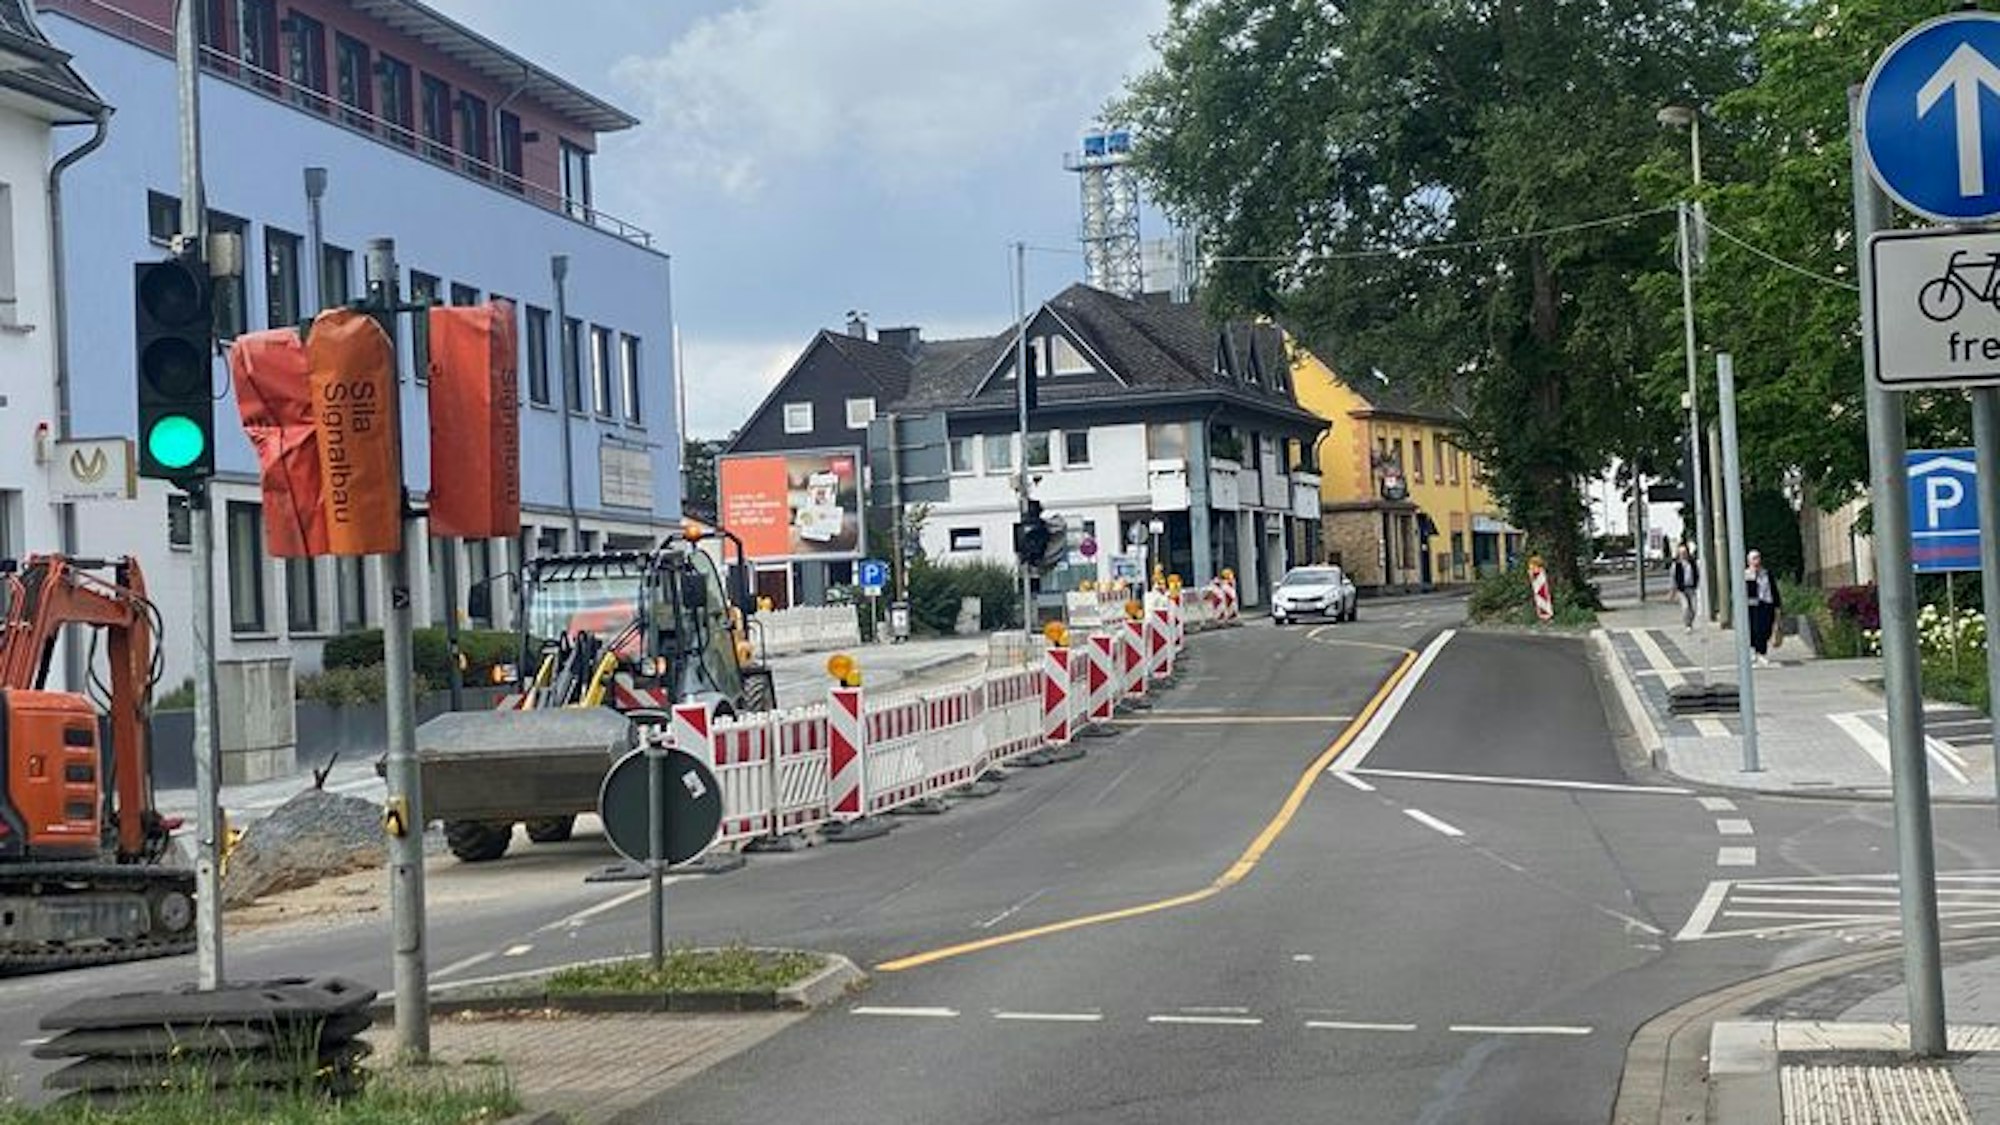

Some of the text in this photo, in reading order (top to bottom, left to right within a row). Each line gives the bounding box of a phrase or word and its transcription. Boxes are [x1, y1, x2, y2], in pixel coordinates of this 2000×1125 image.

[351, 381, 376, 433] Sila
[324, 383, 351, 524] Signalbau
[1926, 476, 1964, 528] P
[864, 563, 879, 585] P
